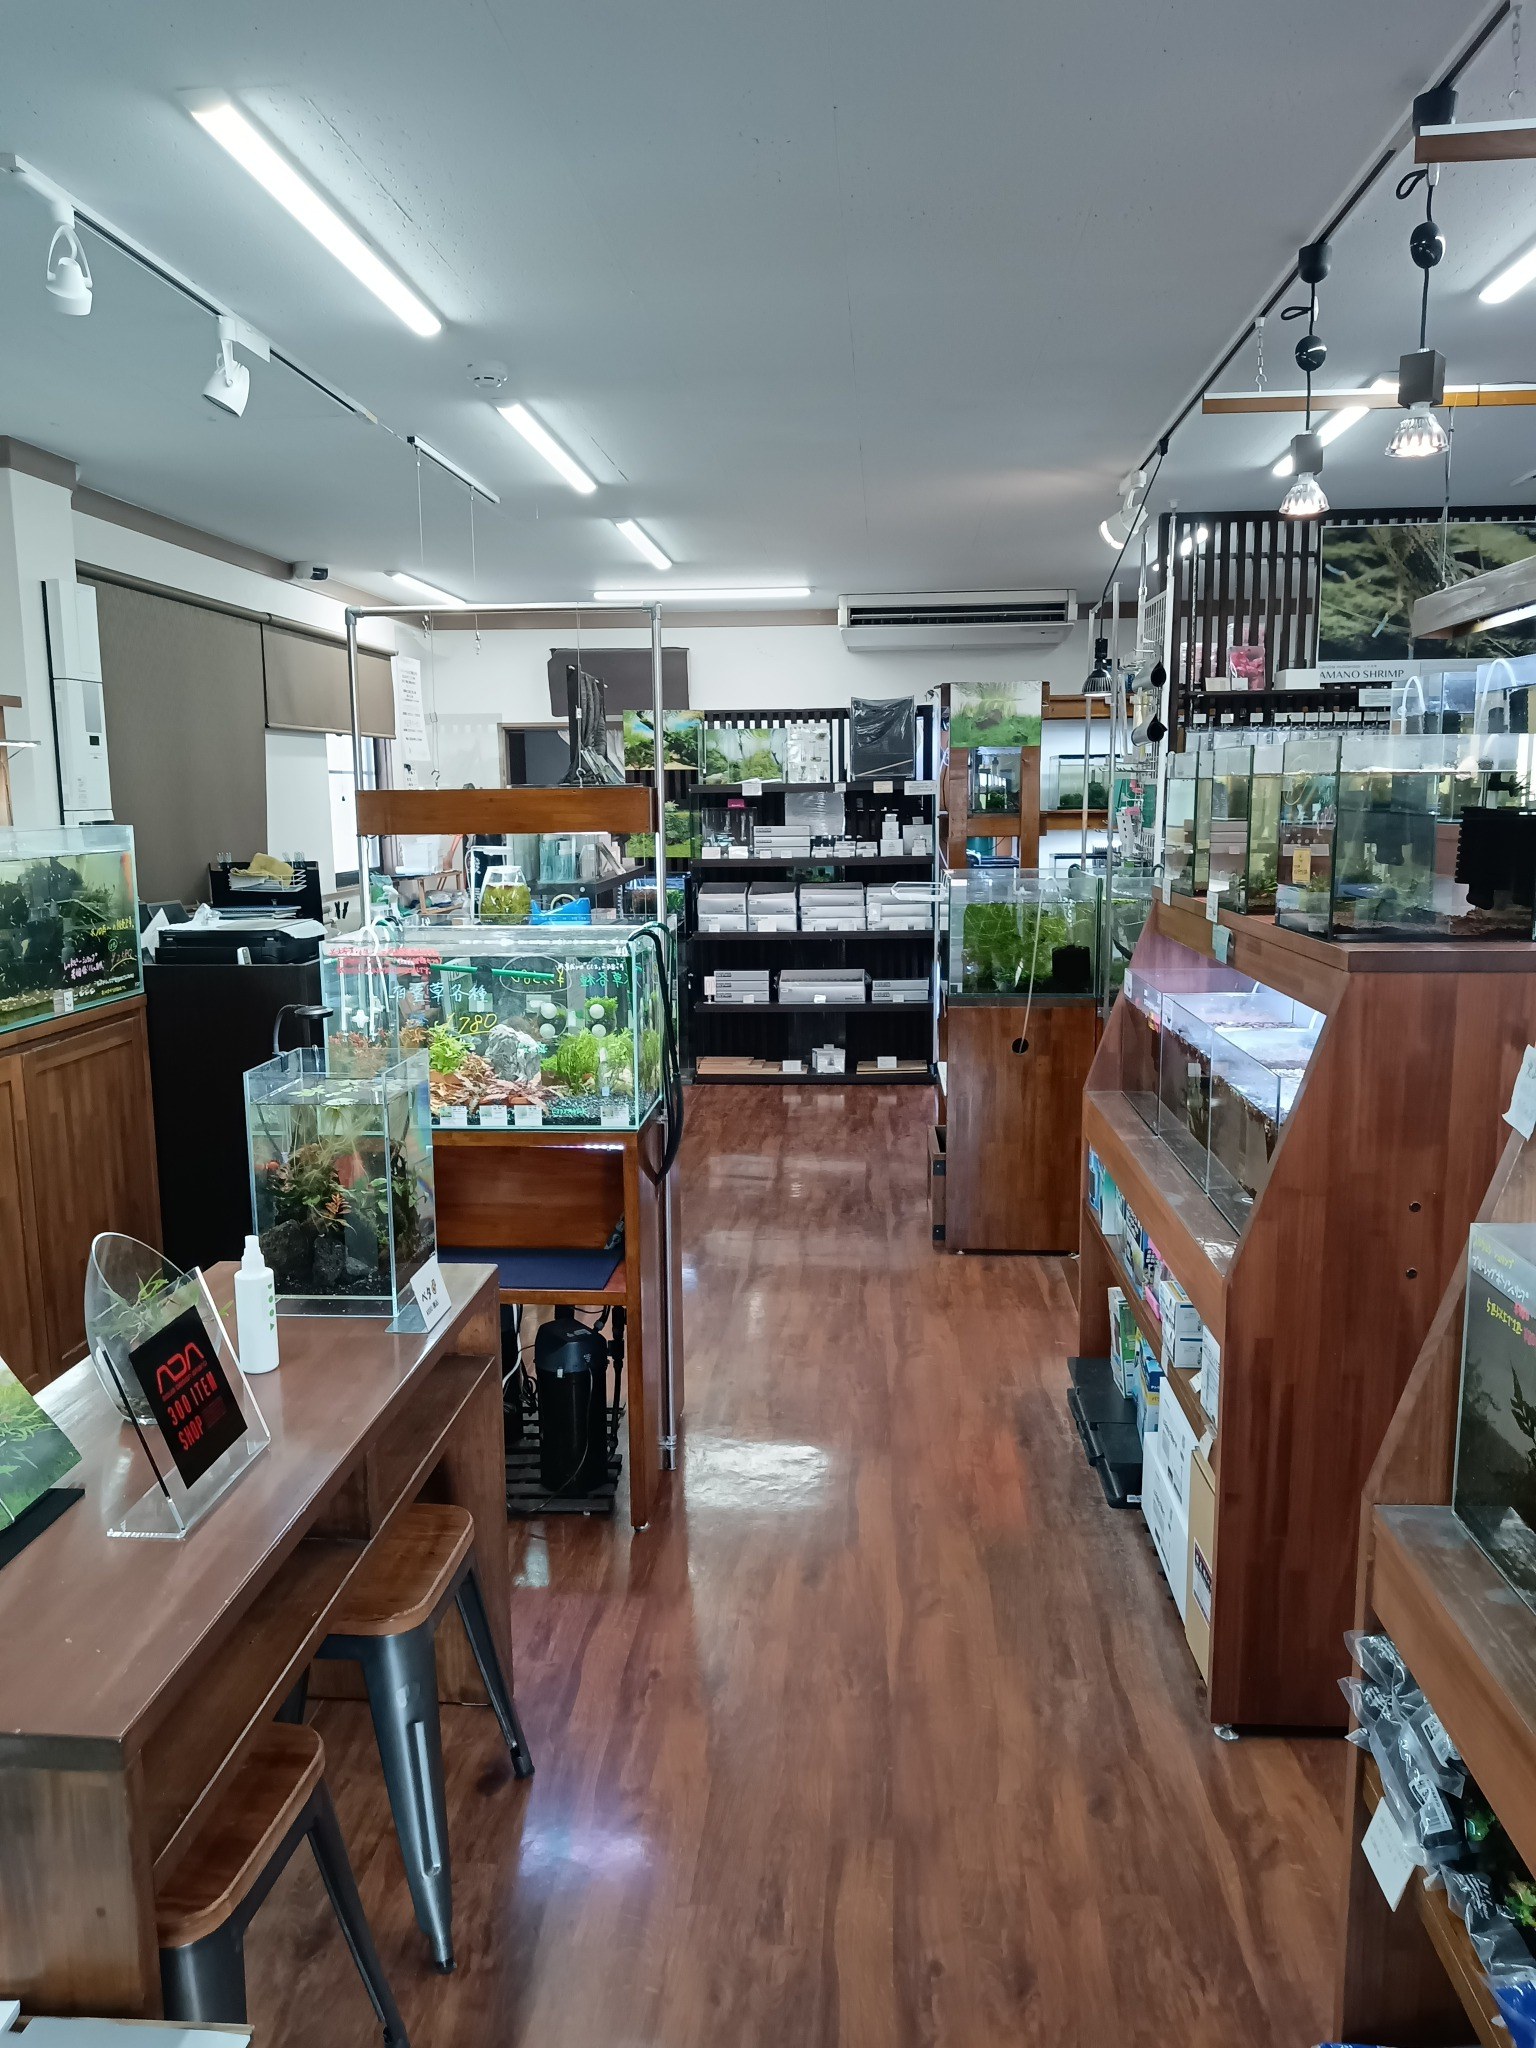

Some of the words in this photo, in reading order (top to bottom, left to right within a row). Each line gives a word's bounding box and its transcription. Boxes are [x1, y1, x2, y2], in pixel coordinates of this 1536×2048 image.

[1320, 670, 1360, 679] AMANO
[1363, 669, 1404, 679] SHRIMP
[167, 1394, 192, 1426] 300
[178, 1415, 204, 1450] SHOP
